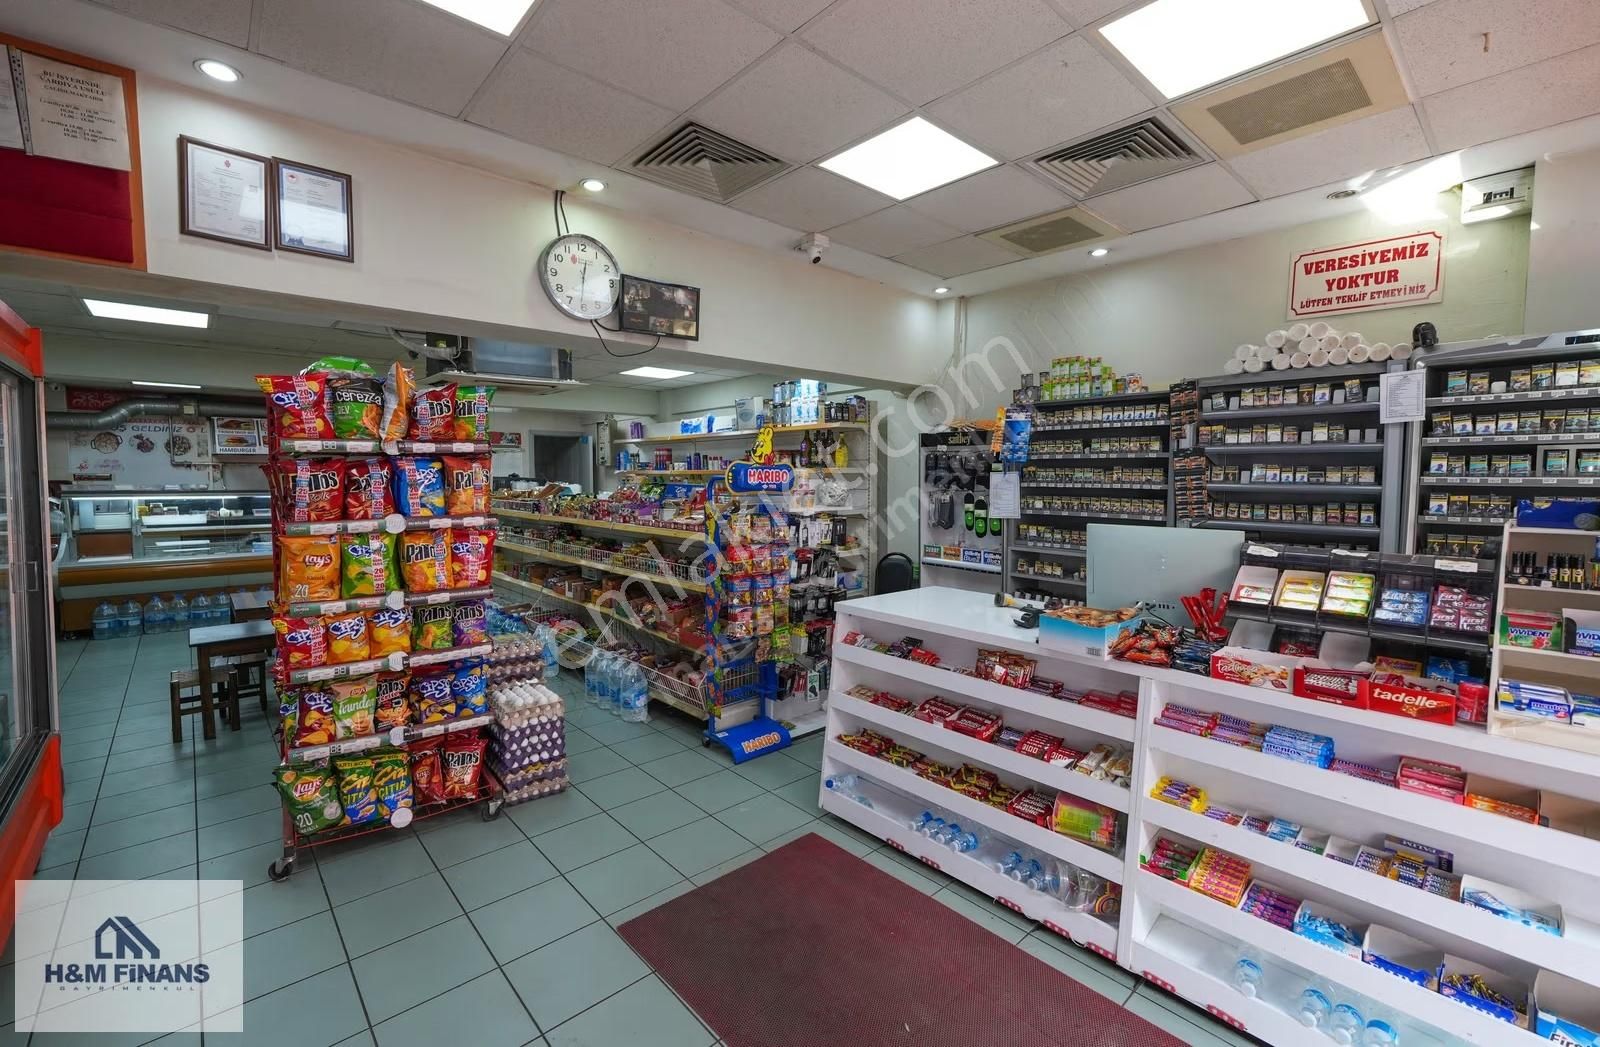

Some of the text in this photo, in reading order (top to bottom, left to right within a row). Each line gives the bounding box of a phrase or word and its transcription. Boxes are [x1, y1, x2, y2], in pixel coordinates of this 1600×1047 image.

[564, 245, 571, 254] 11
[577, 243, 587, 253] 12
[553, 253, 564, 263] 10
[595, 251, 599, 260] 1
[1303, 240, 1430, 275] VERESİYEMİZ
[550, 268, 558, 277] 9
[603, 264, 611, 273] 2
[609, 279, 615, 288] 3
[1326, 269, 1399, 292] YOKTUR
[556, 283, 564, 293] 8
[566, 295, 574, 304] 7
[1300, 296, 1334, 310] LÜTFEN
[1335, 290, 1368, 304] TEKLİF
[335, 391, 382, 406] cerezza
[219, 446, 257, 454] HAMBURGER
[747, 468, 789, 484] HARIBO
[295, 584, 309, 598] 20
[1373, 687, 1440, 709] tadelle
[1531, 700, 1569, 713] mentos
[741, 732, 782, 754] HARIBO
[1266, 743, 1302, 756] mentos
[297, 812, 313, 828] 20
